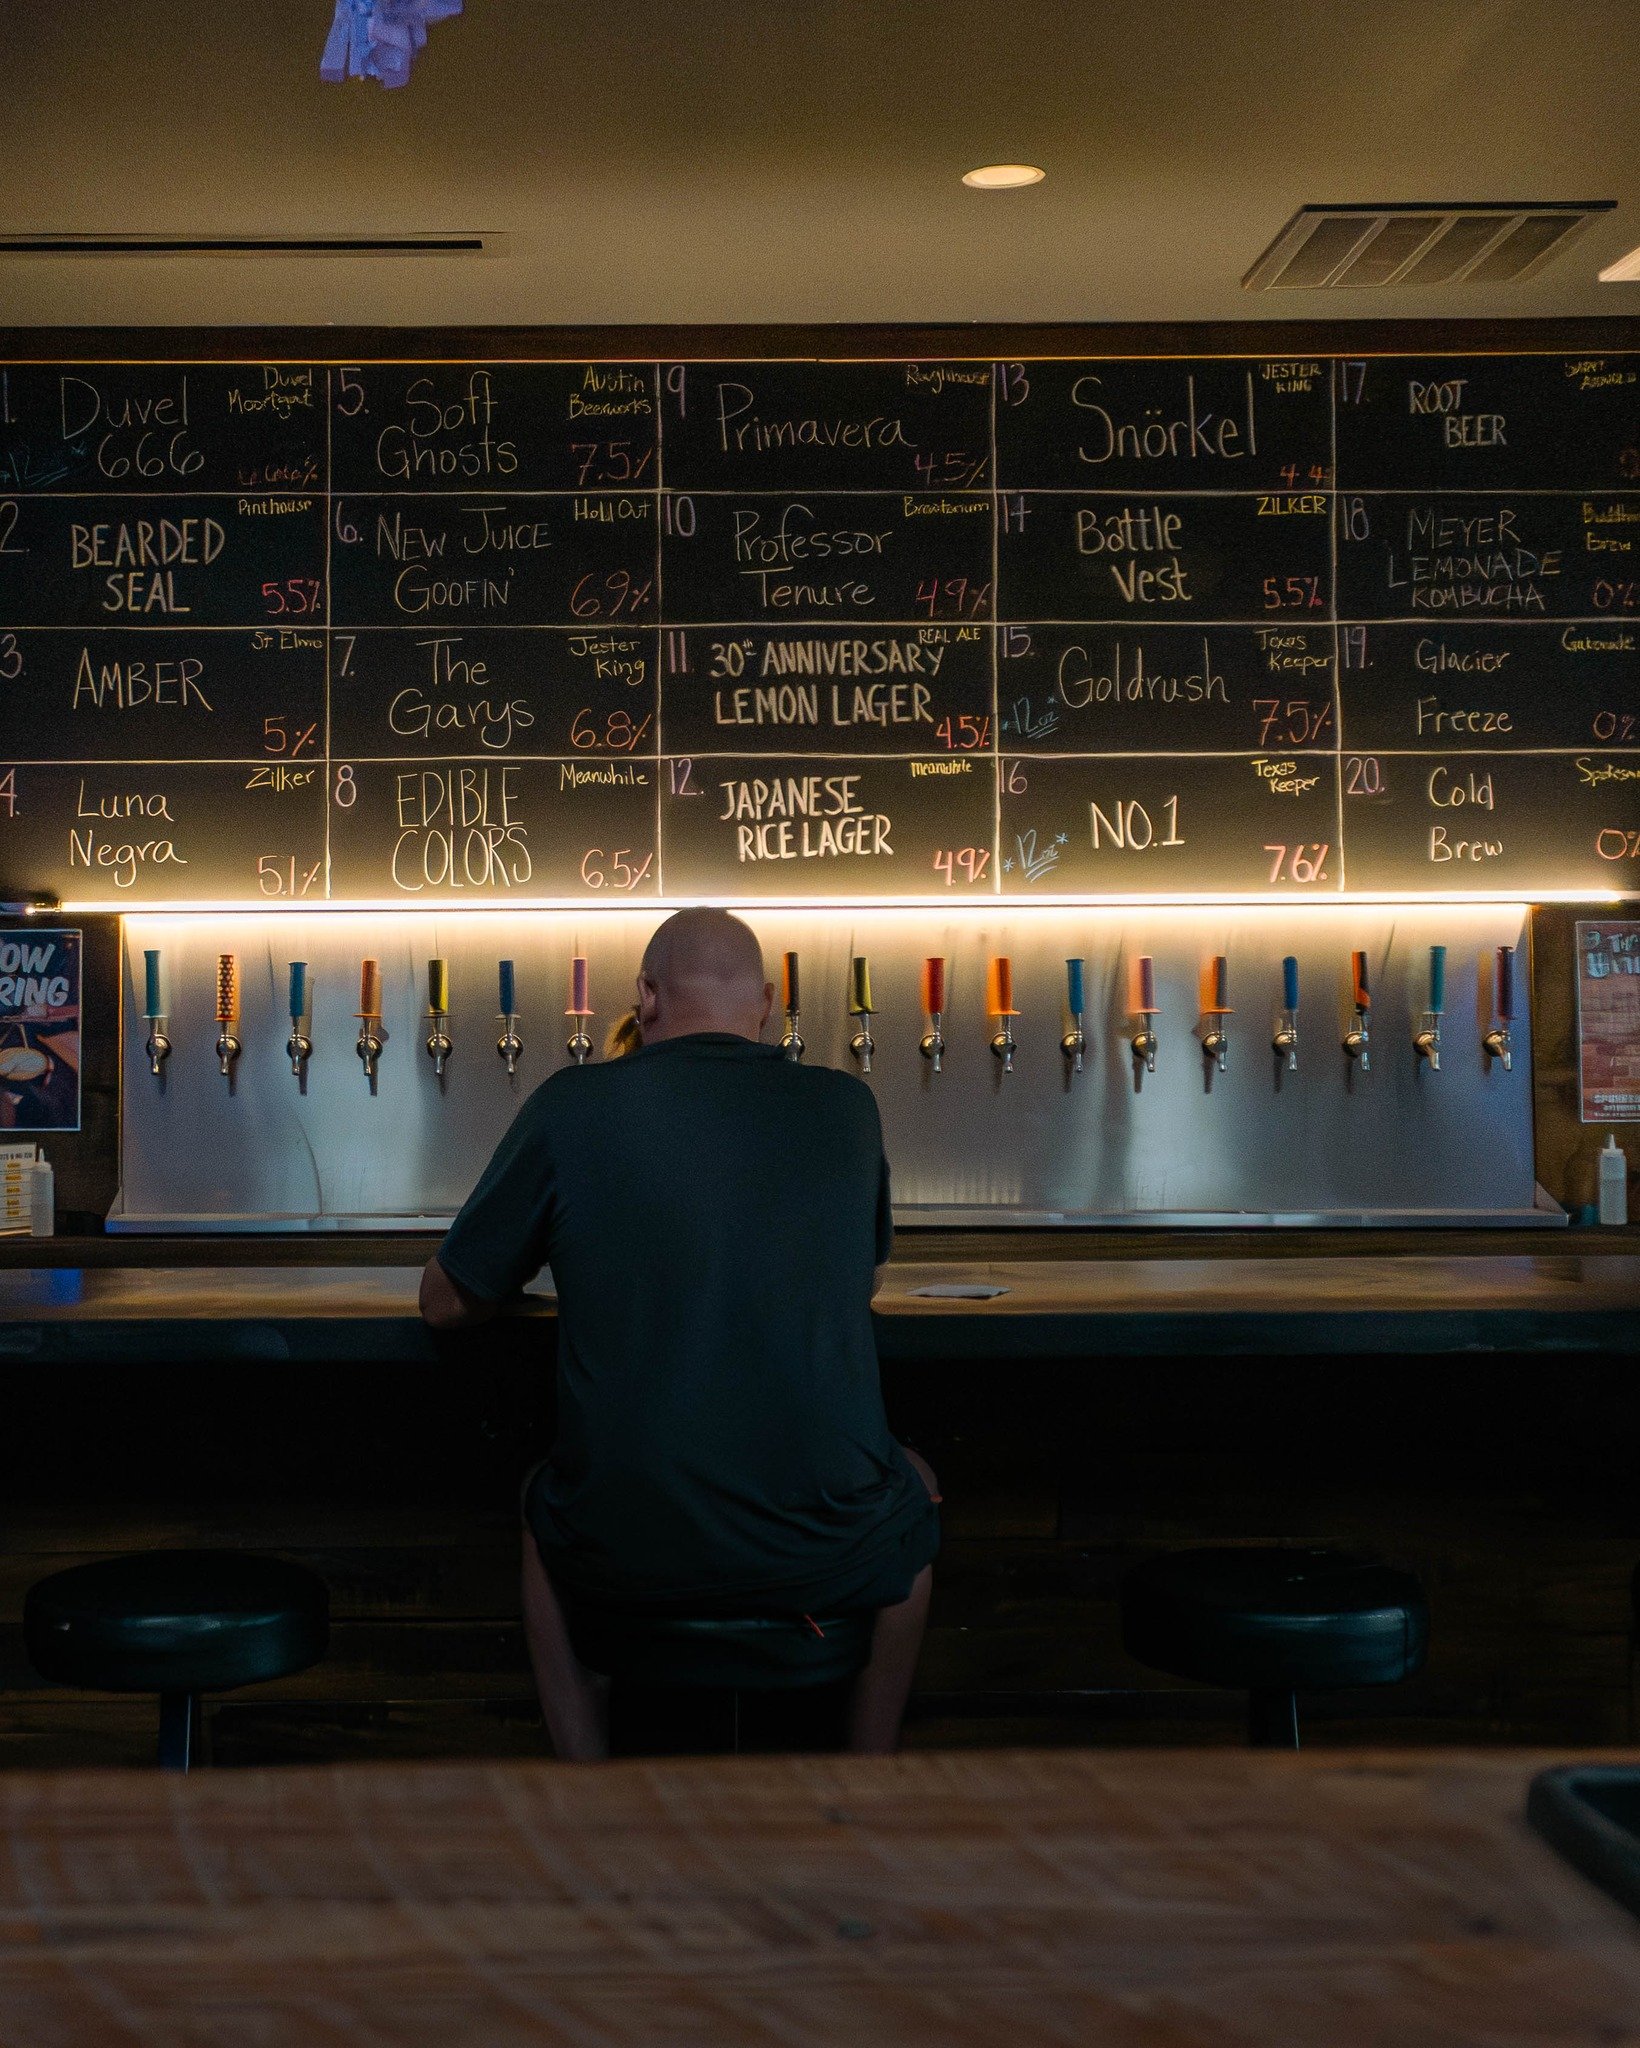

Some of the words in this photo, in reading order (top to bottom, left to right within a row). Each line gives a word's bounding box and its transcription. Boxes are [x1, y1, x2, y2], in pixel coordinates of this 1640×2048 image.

[264, 366, 313, 390] Duvel
[338, 367, 369, 415] 5.
[583, 366, 646, 393] Austin
[667, 365, 687, 418] 9
[1001, 363, 1030, 406] 13
[1261, 363, 1323, 381] JESTER
[1274, 379, 1312, 395] KING
[61, 374, 189, 440] Duvel
[405, 371, 499, 437] Soft
[716, 383, 918, 451] Primavera
[1071, 370, 1256, 463] Snörkel
[1408, 379, 1469, 415] ROOT
[377, 425, 518, 480] Ghosts
[1445, 414, 1508, 449] BEER
[98, 430, 206, 479] 666
[571, 441, 653, 486] 7.5%
[336, 501, 364, 543] 6.
[666, 495, 697, 538] 10
[1256, 495, 1327, 516] ZILKER
[1343, 497, 1371, 541] 18
[70, 517, 226, 570] BEARDED
[378, 512, 446, 561] NEW
[461, 507, 552, 554] JUICE
[733, 503, 893, 562] Professor
[1076, 505, 1183, 555] Battle
[1407, 507, 1522, 551] MEYER
[394, 564, 515, 613] GOOFIN'
[740, 566, 876, 608] Tenure
[1110, 557, 1193, 603] Vest
[1387, 548, 1563, 588] LEMONADE
[102, 571, 192, 613] SEAL
[261, 579, 321, 614] 5.5%
[1263, 576, 1326, 609] 5.5%
[1412, 583, 1546, 611] KOMBUCHA
[335, 636, 356, 677] 7.
[568, 636, 641, 656] Jester
[919, 628, 951, 644] REAL
[956, 627, 982, 642] ALE
[1254, 627, 1308, 651] Texas
[1416, 638, 1511, 674] Glacier
[72, 646, 214, 711] AMBER
[416, 637, 490, 685] The
[596, 658, 646, 686] King
[762, 638, 945, 677] ANNIVERSARY
[1059, 637, 1231, 709] Goldrush
[1267, 650, 1334, 676] Keeper
[389, 688, 536, 749] Garys
[714, 684, 819, 726] LEMON
[831, 682, 934, 727] LAGER
[1252, 699, 1333, 747] 7.5%
[1416, 695, 1514, 736] Freeze
[1592, 710, 1637, 741] 0%
[264, 716, 318, 756] 5%
[570, 708, 653, 752] 6.8%
[936, 715, 990, 750] 4.5%
[245, 766, 316, 792] Zilker
[335, 764, 358, 807] 8
[560, 764, 650, 791] Meanwhile
[668, 758, 705, 796] 12.
[999, 760, 1028, 794] 16
[1251, 758, 1298, 778] Texas
[1268, 774, 1322, 796] Keeper
[1344, 757, 1386, 795] 20.
[1428, 766, 1496, 811] Cold
[77, 779, 175, 822] Luna
[397, 767, 524, 828] EDIBLE
[719, 775, 865, 821] JAPANESE
[69, 829, 189, 888] Negra
[392, 827, 533, 890] COLORS
[738, 821, 799, 863] RICE
[802, 814, 895, 858] LAGER
[1430, 826, 1504, 863] Brew
[257, 855, 322, 896] 5.1%
[581, 849, 653, 891] 6.5%
[933, 847, 990, 887] 4.9%
[1264, 844, 1331, 884] 7.6%
